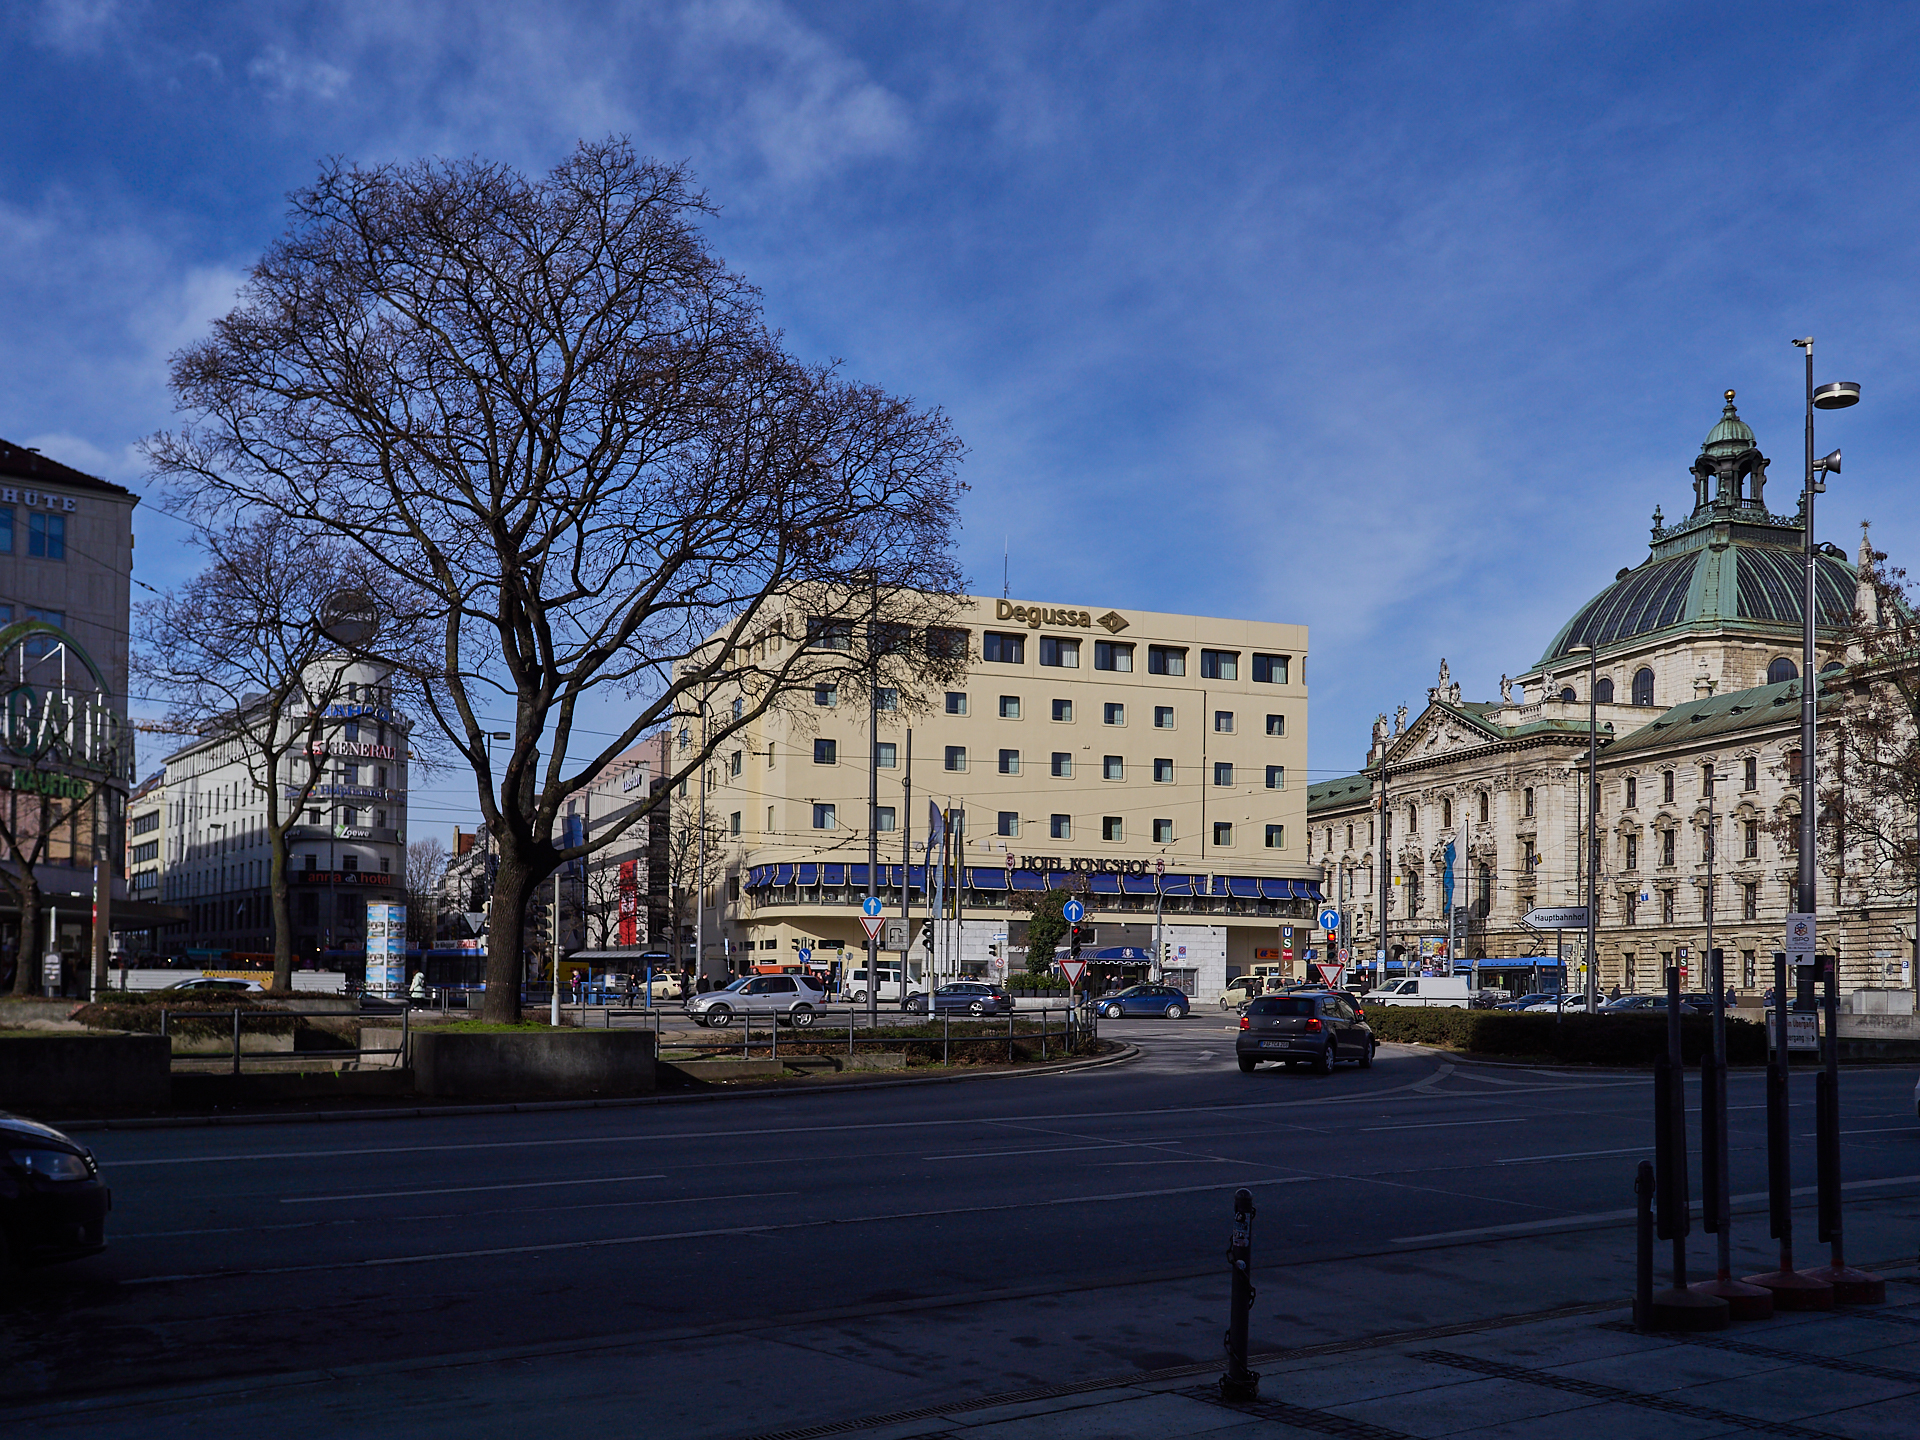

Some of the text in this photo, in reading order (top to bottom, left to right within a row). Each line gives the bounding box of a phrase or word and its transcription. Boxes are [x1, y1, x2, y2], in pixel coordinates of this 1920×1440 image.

[1, 488, 76, 512] HÜTE
[996, 598, 1091, 629] Degussa
[340, 826, 371, 838] Loewe
[1021, 855, 1066, 871] HOTEL
[361, 873, 391, 885] hotel
[1534, 913, 1585, 923] Hauptbahnhof
[1284, 927, 1291, 937] U
[1283, 938, 1292, 948] S
[1680, 958, 1687, 966] S
